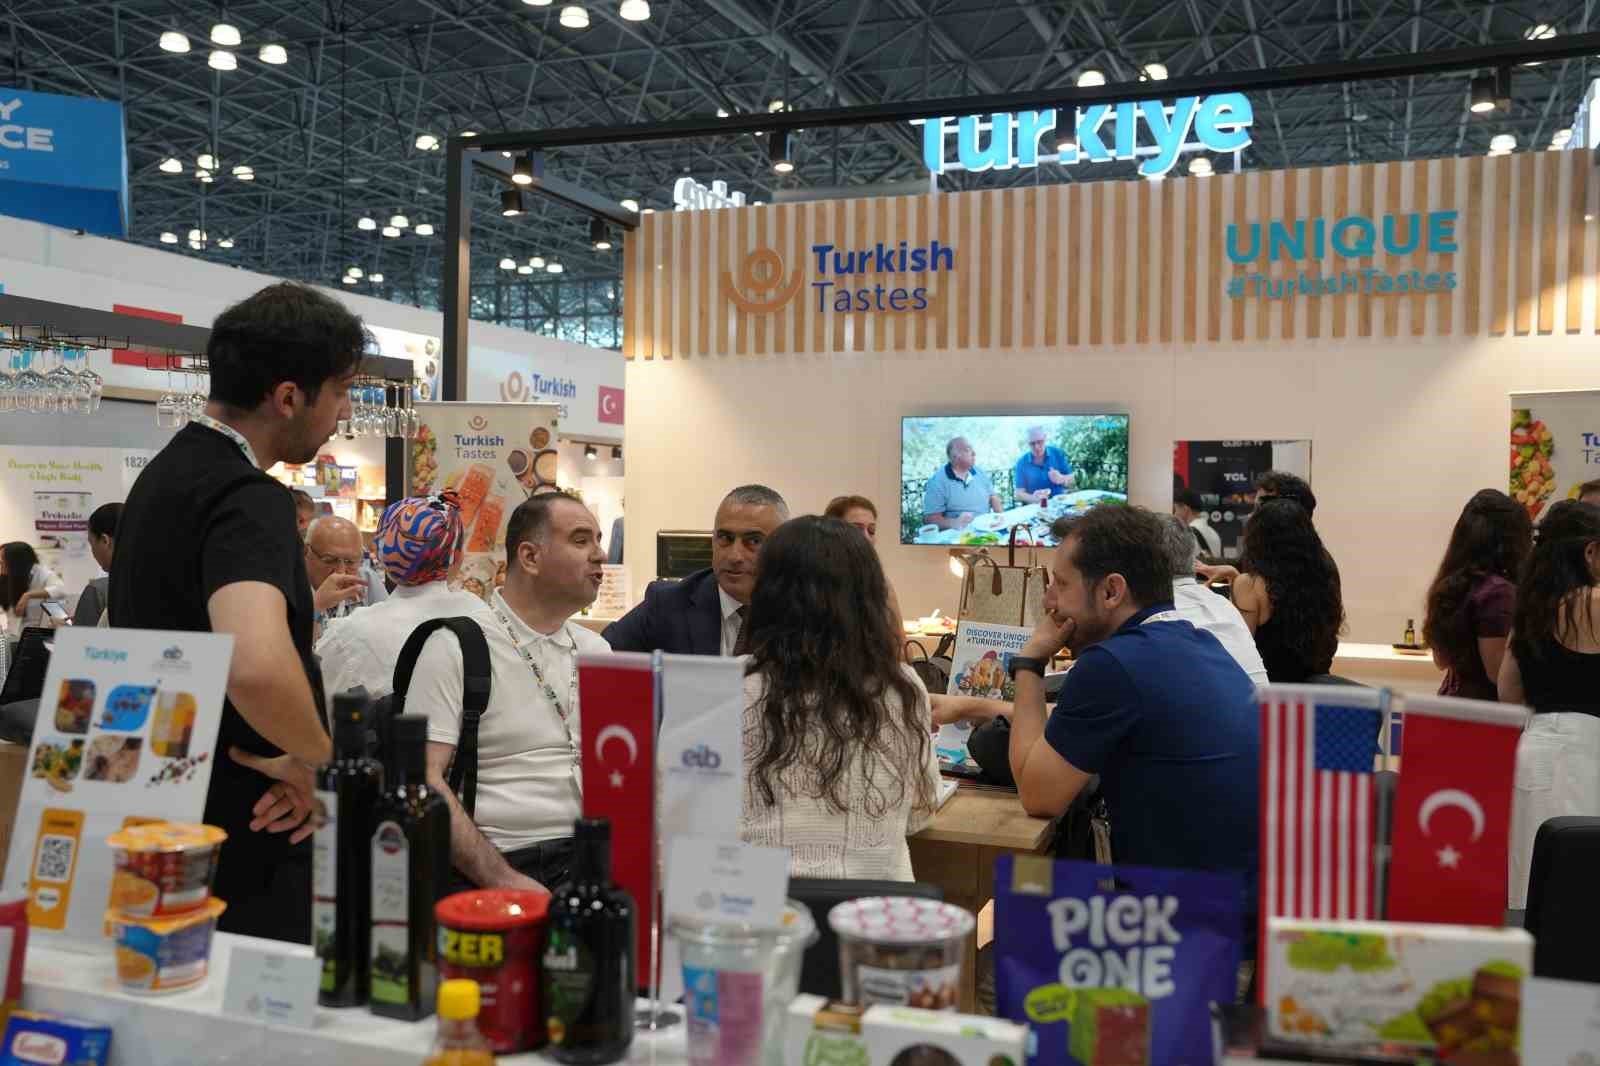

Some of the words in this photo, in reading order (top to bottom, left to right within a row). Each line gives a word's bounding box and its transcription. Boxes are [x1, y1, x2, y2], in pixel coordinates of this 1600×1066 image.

[0, 124, 54, 152] CE
[1226, 210, 1458, 265] UNIQUE
[811, 240, 954, 275] Turkish
[811, 281, 928, 313] Tastes
[1227, 267, 1457, 302] #TurkishTastes
[532, 373, 576, 398] Turkish
[454, 434, 504, 447] Turkish
[455, 447, 497, 460] Tastes
[1223, 472, 1248, 482] TCL
[966, 628, 1002, 640] DISCOVER
[1003, 631, 1032, 643] UNIQU
[681, 744, 722, 769] eib
[1046, 894, 1182, 952] PICK
[1059, 945, 1176, 1000] ONE
